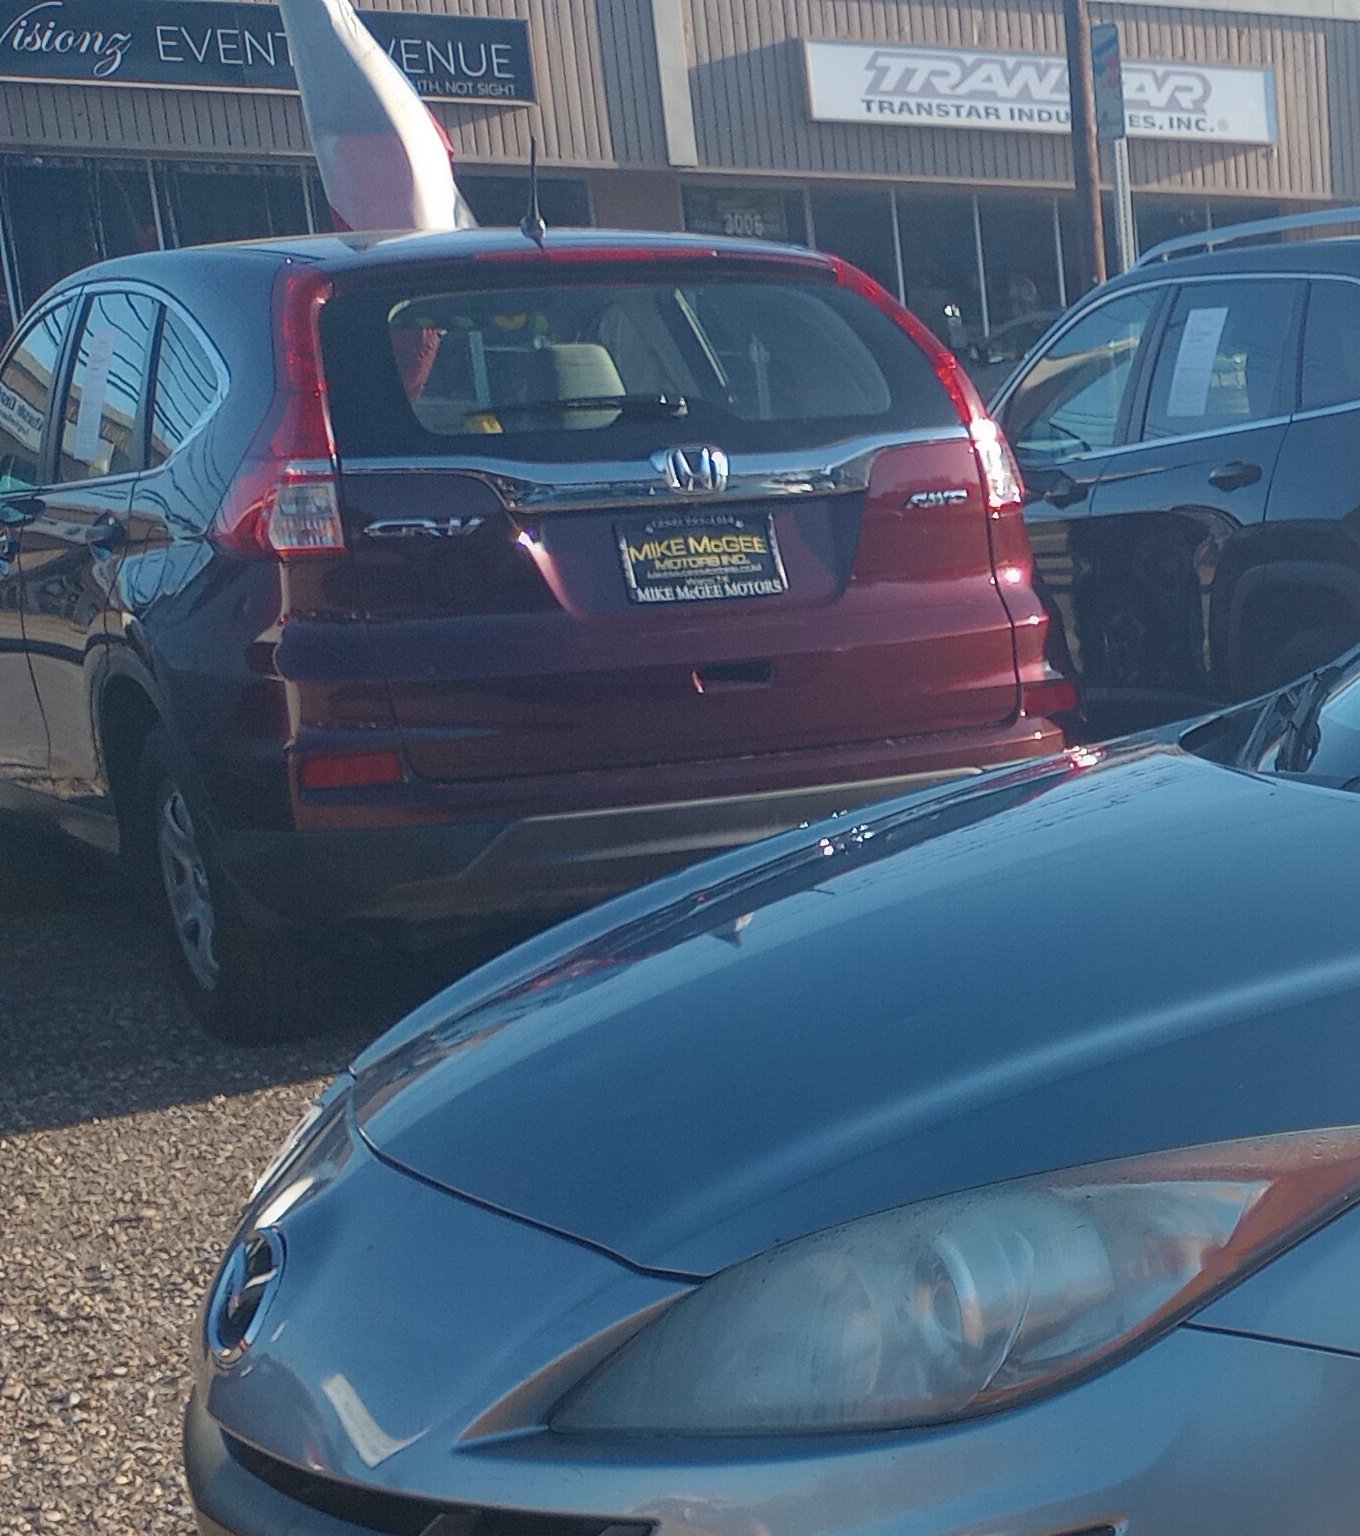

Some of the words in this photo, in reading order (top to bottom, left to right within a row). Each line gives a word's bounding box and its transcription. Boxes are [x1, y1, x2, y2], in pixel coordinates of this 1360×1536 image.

[445, 82, 473, 95] NOT
[477, 83, 515, 96] SIGHT
[866, 51, 1211, 113] TRANAR
[861, 99, 1001, 120] TRANSTAR
[1009, 107, 1164, 131] INDUES,
[1169, 116, 1214, 132] INC.
[629, 537, 687, 564] MIKE
[655, 557, 720, 571] MOTORS
[637, 586, 675, 603] MIKE
[675, 582, 725, 600] McGEE
[726, 578, 783, 596] MOTORS
